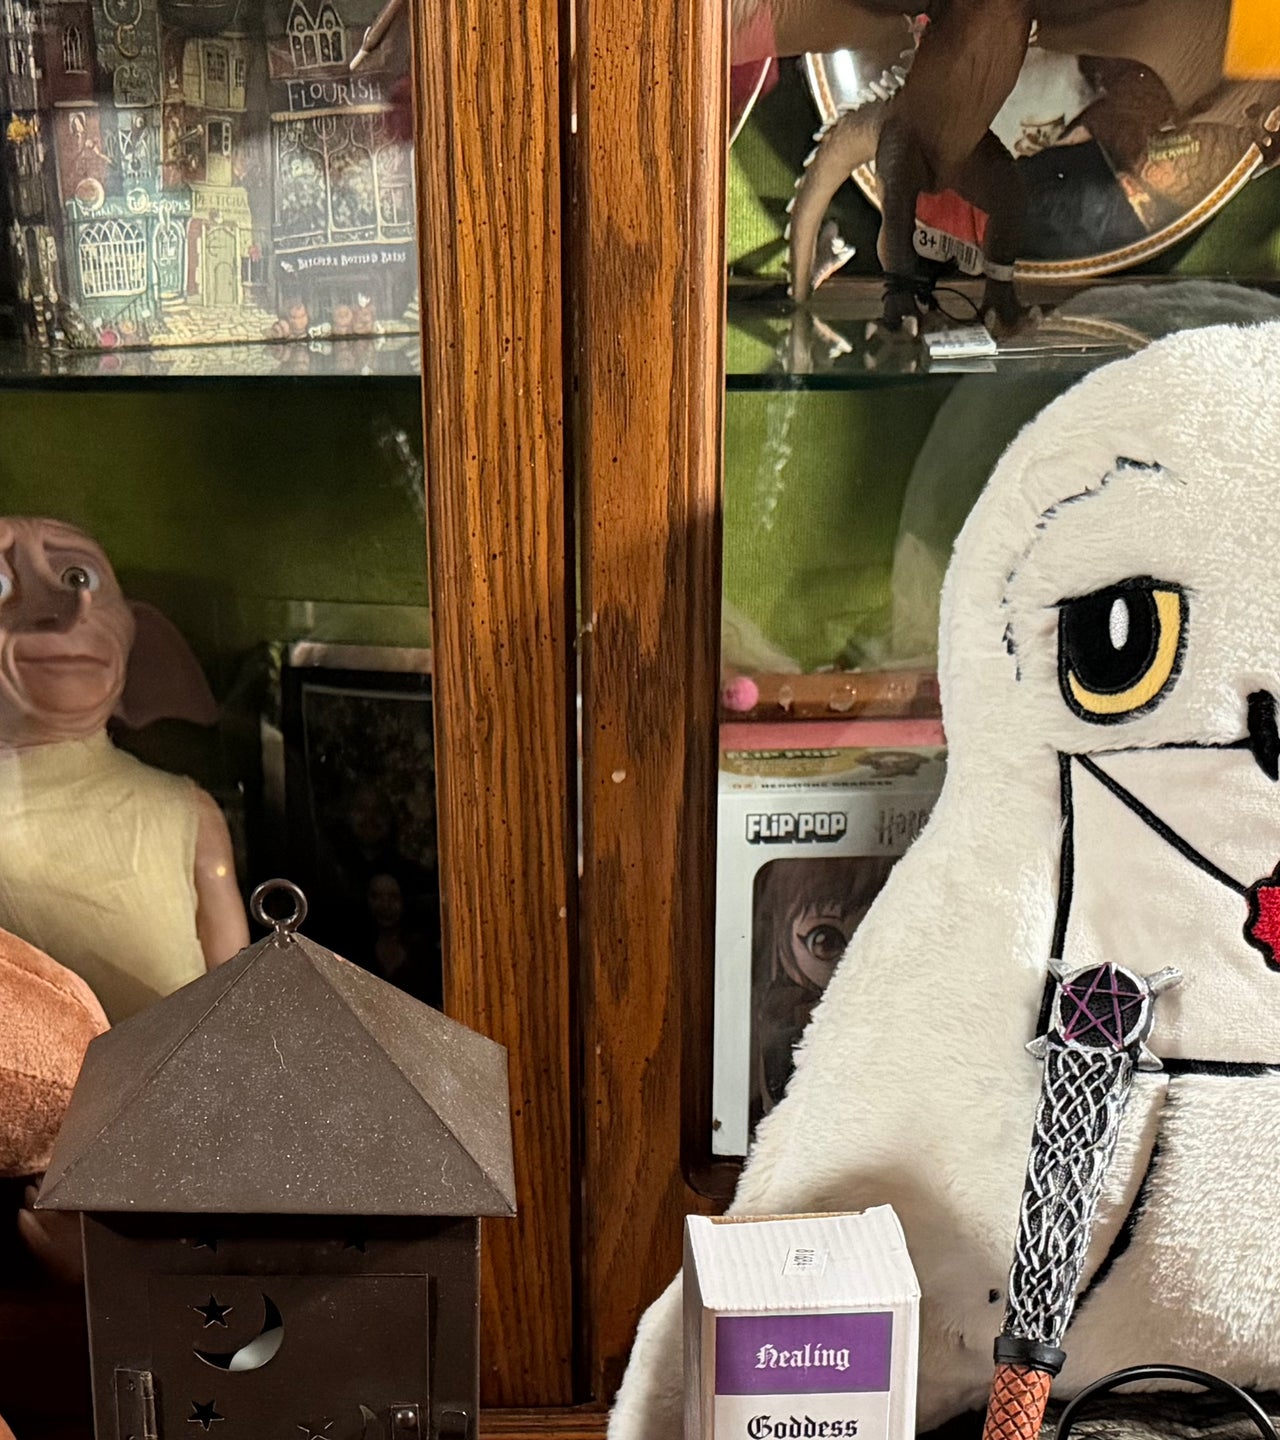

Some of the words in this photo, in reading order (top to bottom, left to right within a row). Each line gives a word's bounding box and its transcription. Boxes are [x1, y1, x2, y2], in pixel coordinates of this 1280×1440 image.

[287, 78, 383, 112] FLOURISH
[919, 230, 937, 249] 3+
[797, 811, 848, 844] POP
[754, 1342, 851, 1371] Healing
[747, 1414, 859, 1440] Goddess
